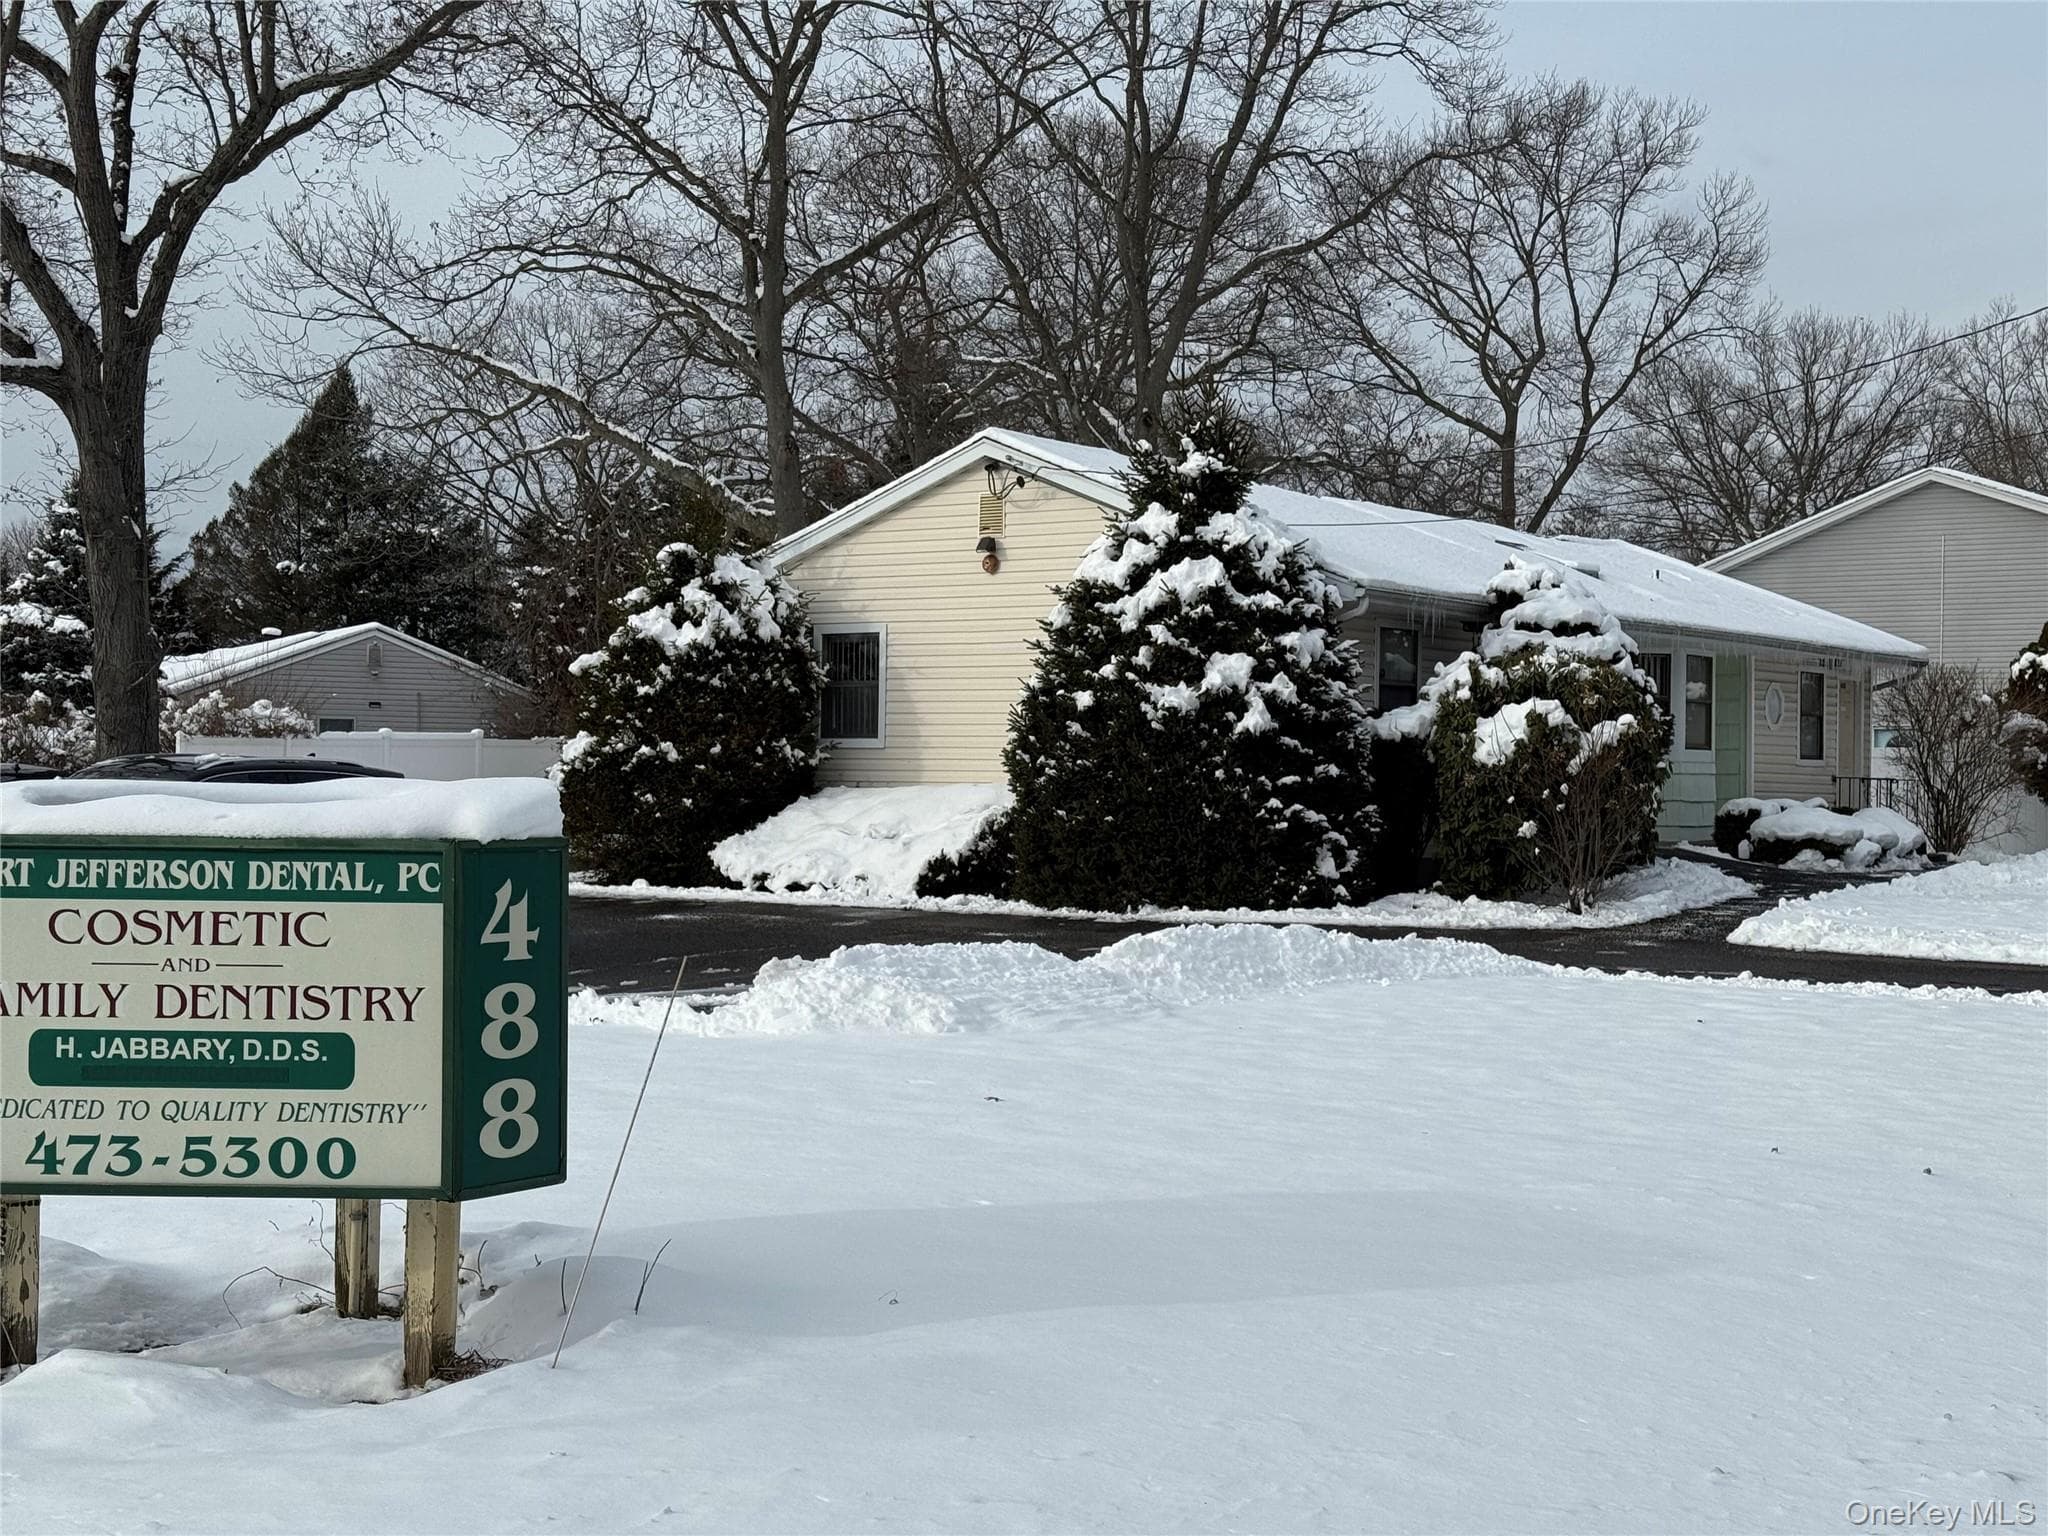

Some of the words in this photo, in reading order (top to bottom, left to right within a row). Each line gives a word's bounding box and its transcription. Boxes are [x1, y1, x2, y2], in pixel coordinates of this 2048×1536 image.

[0, 857, 35, 888] RT
[47, 858, 235, 890] JEFFERSON
[247, 861, 384, 894] DENTAL,
[397, 862, 441, 893] PC
[48, 908, 331, 949] COSMETIC
[160, 957, 210, 973] AND
[154, 983, 425, 1022] DENTISTRY
[56, 1036, 82, 1059] H.
[91, 1037, 235, 1064] JABBARY,
[243, 1039, 328, 1062] D.D.S.
[0, 1098, 104, 1120] DICATED
[117, 1099, 150, 1121] TO
[161, 1100, 268, 1123] QUALITY
[25, 1130, 356, 1179] 473-5300
